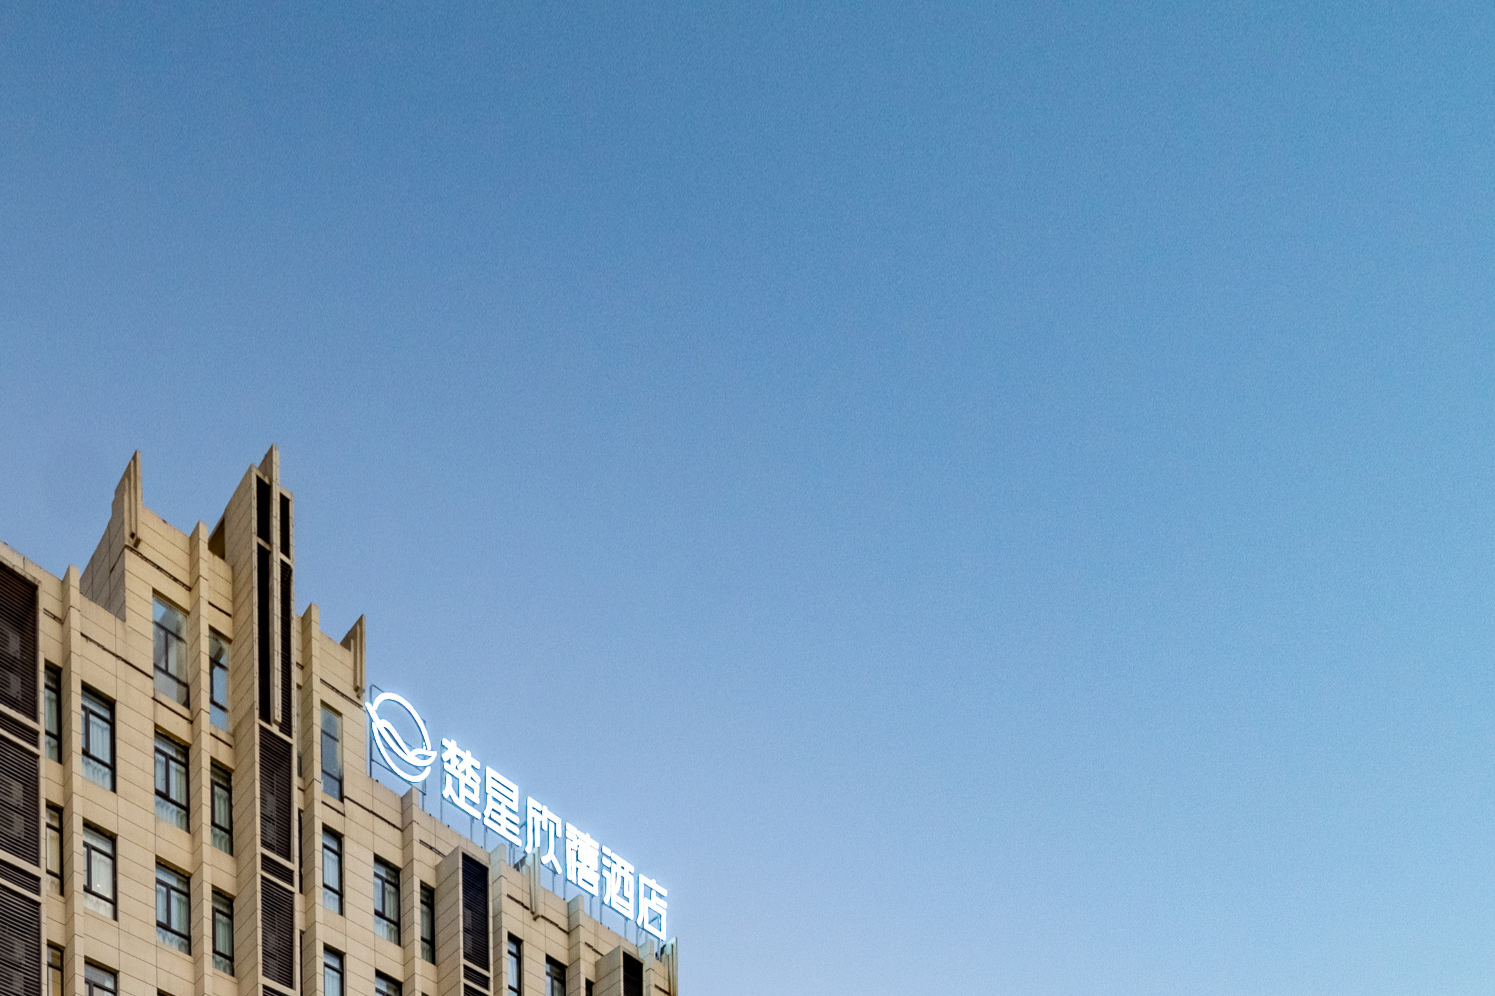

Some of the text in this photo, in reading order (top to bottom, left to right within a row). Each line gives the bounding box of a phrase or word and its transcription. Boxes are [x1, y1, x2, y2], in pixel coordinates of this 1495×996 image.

[441, 737, 668, 942] 楚星欣禧酒店
